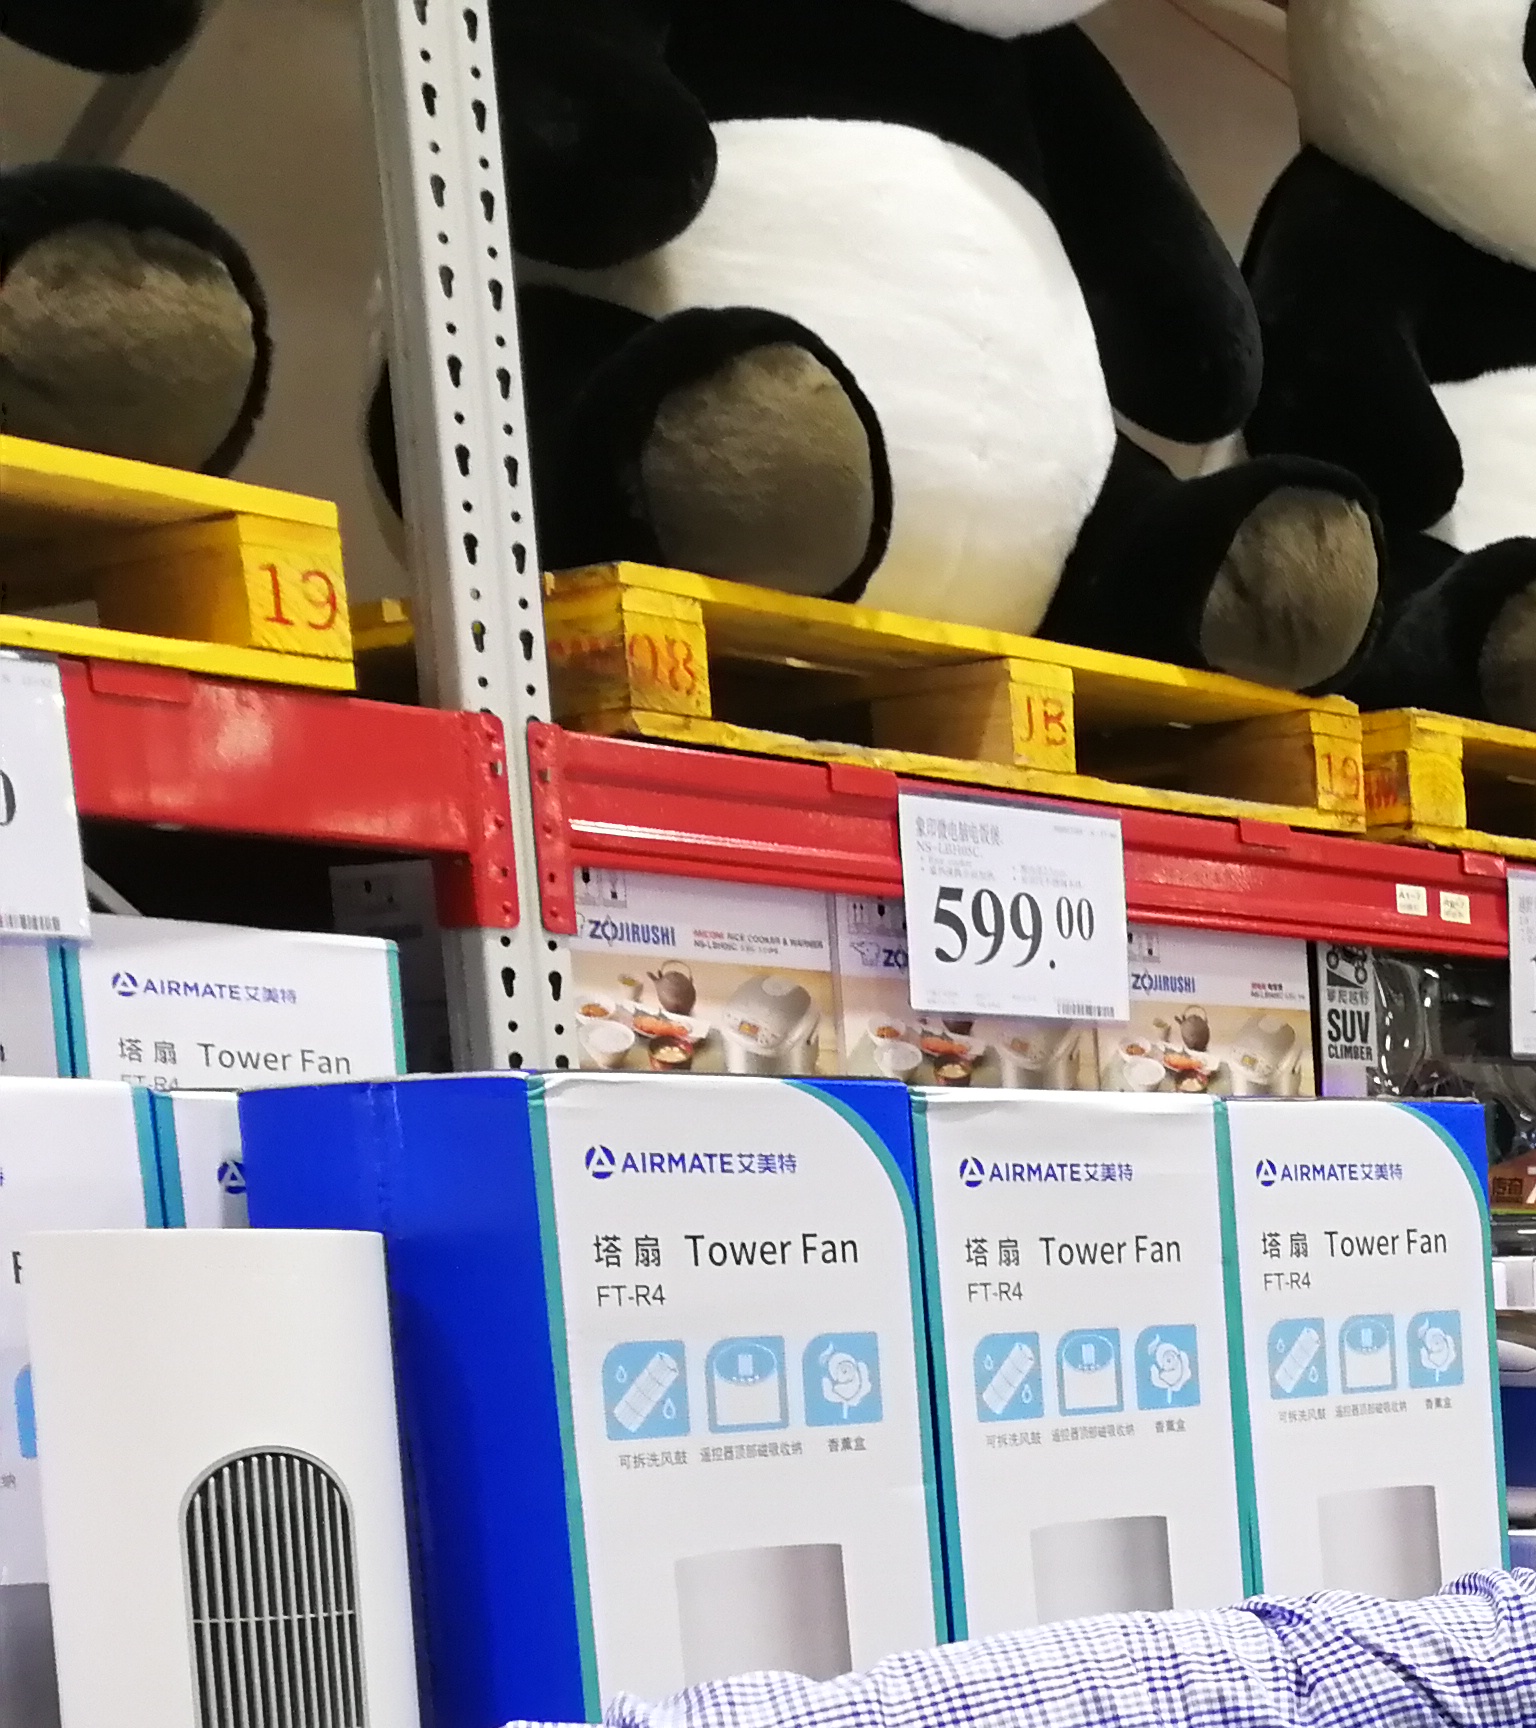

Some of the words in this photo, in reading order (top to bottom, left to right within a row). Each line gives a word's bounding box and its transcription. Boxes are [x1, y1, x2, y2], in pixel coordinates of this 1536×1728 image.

[588, 916, 676, 947] ZOJIRUSHI
[143, 978, 241, 1002] AIRMATE
[1131, 972, 1196, 995] ZOJIRUSHI
[1326, 1008, 1370, 1044] SUV
[118, 1037, 179, 1066] 塔扇
[197, 1041, 292, 1073] Tower
[300, 1048, 352, 1077] Fan
[1327, 1044, 1373, 1062] CLIMBER
[621, 1150, 735, 1176] AIRMATE
[737, 1150, 798, 1176] 艾美特
[988, 1160, 1082, 1184] AIRMATE
[1084, 1160, 1134, 1184] 艾美特
[1280, 1160, 1359, 1184] AIRMATE
[1360, 1160, 1403, 1183] 艾美特
[593, 1234, 663, 1269] 塔扇
[685, 1233, 792, 1267] Tower
[801, 1232, 860, 1265] Fan
[965, 1236, 1021, 1269] 塔扇
[1039, 1235, 1127, 1268] Tower
[1134, 1235, 1182, 1265] Fan
[1261, 1230, 1309, 1260] 塔扇
[1324, 1228, 1401, 1260] Tower
[1405, 1227, 1448, 1256] Fan
[967, 1281, 1023, 1303] FT-R4
[1263, 1270, 1313, 1292] FT-R4
[595, 1283, 667, 1308] FT-R4
[619, 1449, 688, 1471] 可拆洗风鼓
